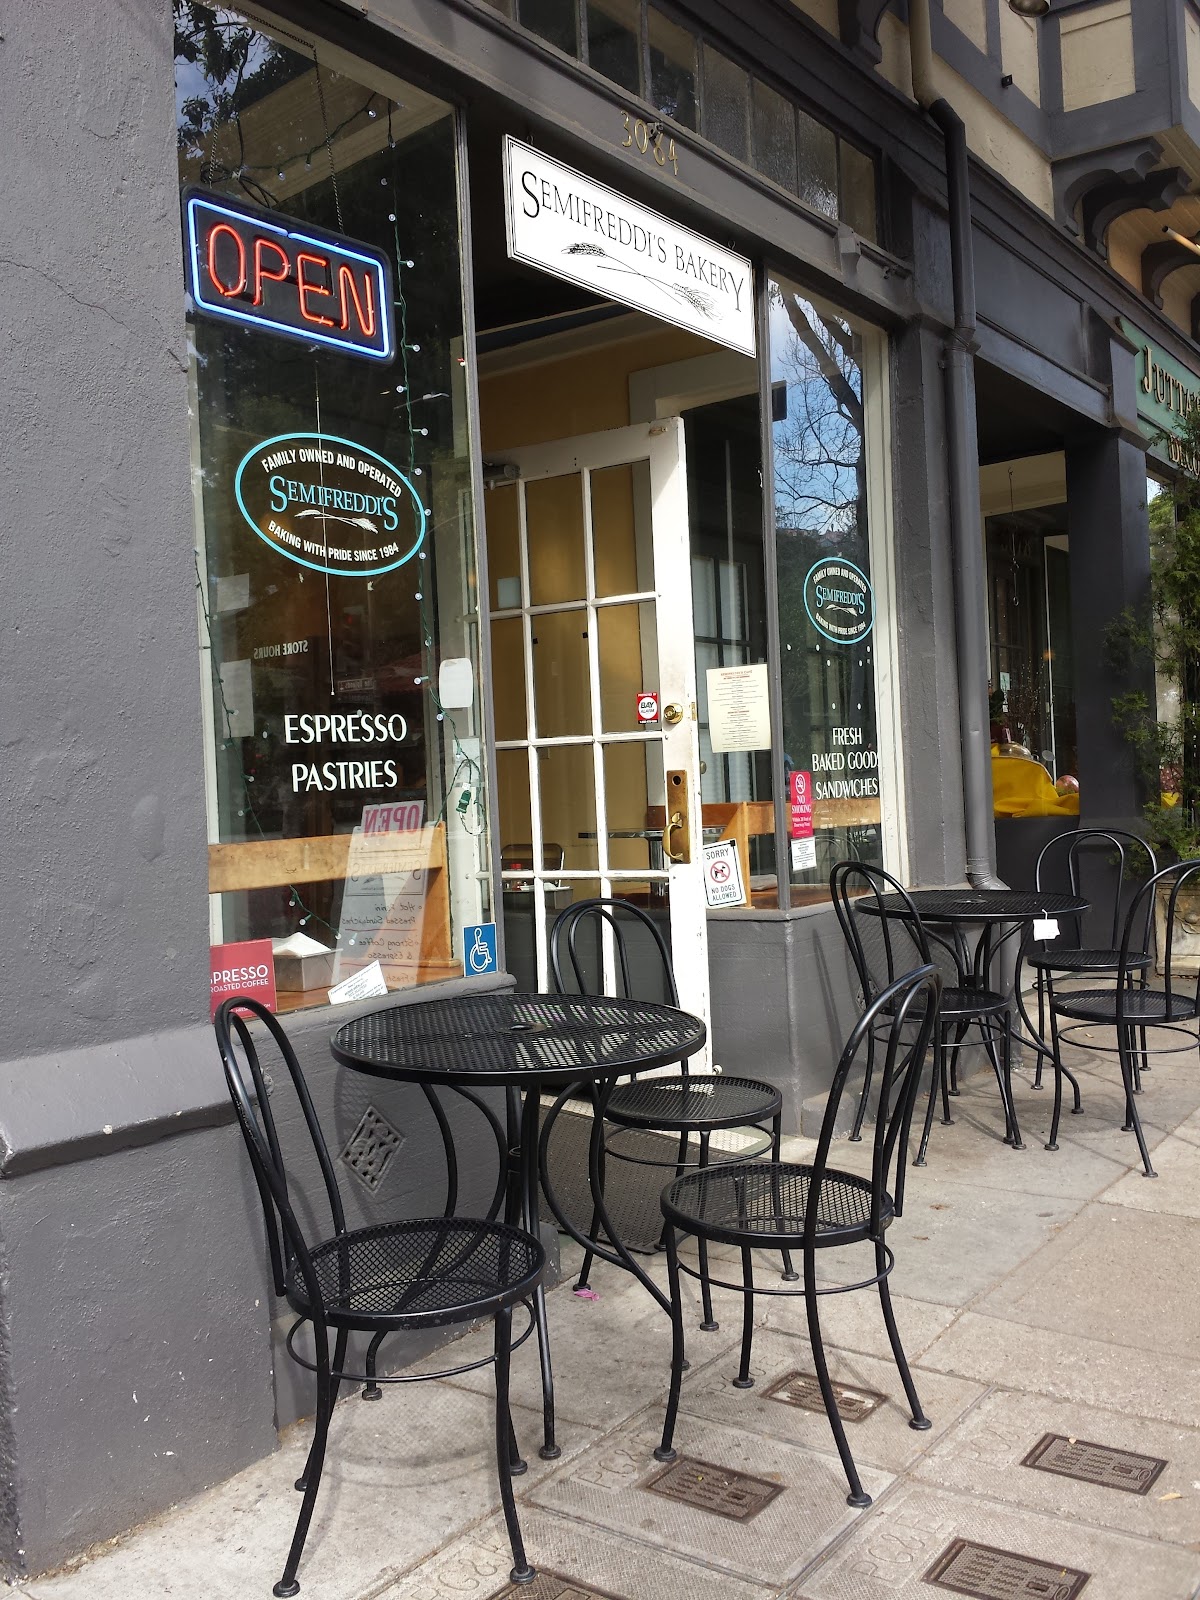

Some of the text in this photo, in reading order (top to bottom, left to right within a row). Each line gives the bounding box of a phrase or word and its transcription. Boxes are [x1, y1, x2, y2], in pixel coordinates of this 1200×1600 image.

[521, 170, 744, 313] SEMIFREDDI'S BAKERY
[207, 223, 376, 337] OPEN
[261, 449, 402, 498] FAMILY OWNED AND OPERATED
[269, 475, 399, 531] SEMIFREDDI'S
[268, 520, 399, 562] BAKING WITH PRIDE SINCE 1984
[640, 701, 654, 709] BAY
[284, 713, 407, 744] ESPRESSO
[832, 727, 862, 745] FRESH
[812, 751, 879, 772] BAKED GOOD
[292, 759, 398, 793] PASTRIES
[797, 795, 805, 804] NO
[816, 778, 878, 801] SANDWICHES
[792, 805, 811, 813] SMOKING
[706, 848, 729, 860] SORRY
[713, 891, 737, 901] ALLOWED
[721, 884, 735, 892] DOGS
[210, 964, 268, 985] PRESSO
[210, 978, 269, 993] ROASTED COFFEE
[849, 1510, 943, 1582] PG&E
